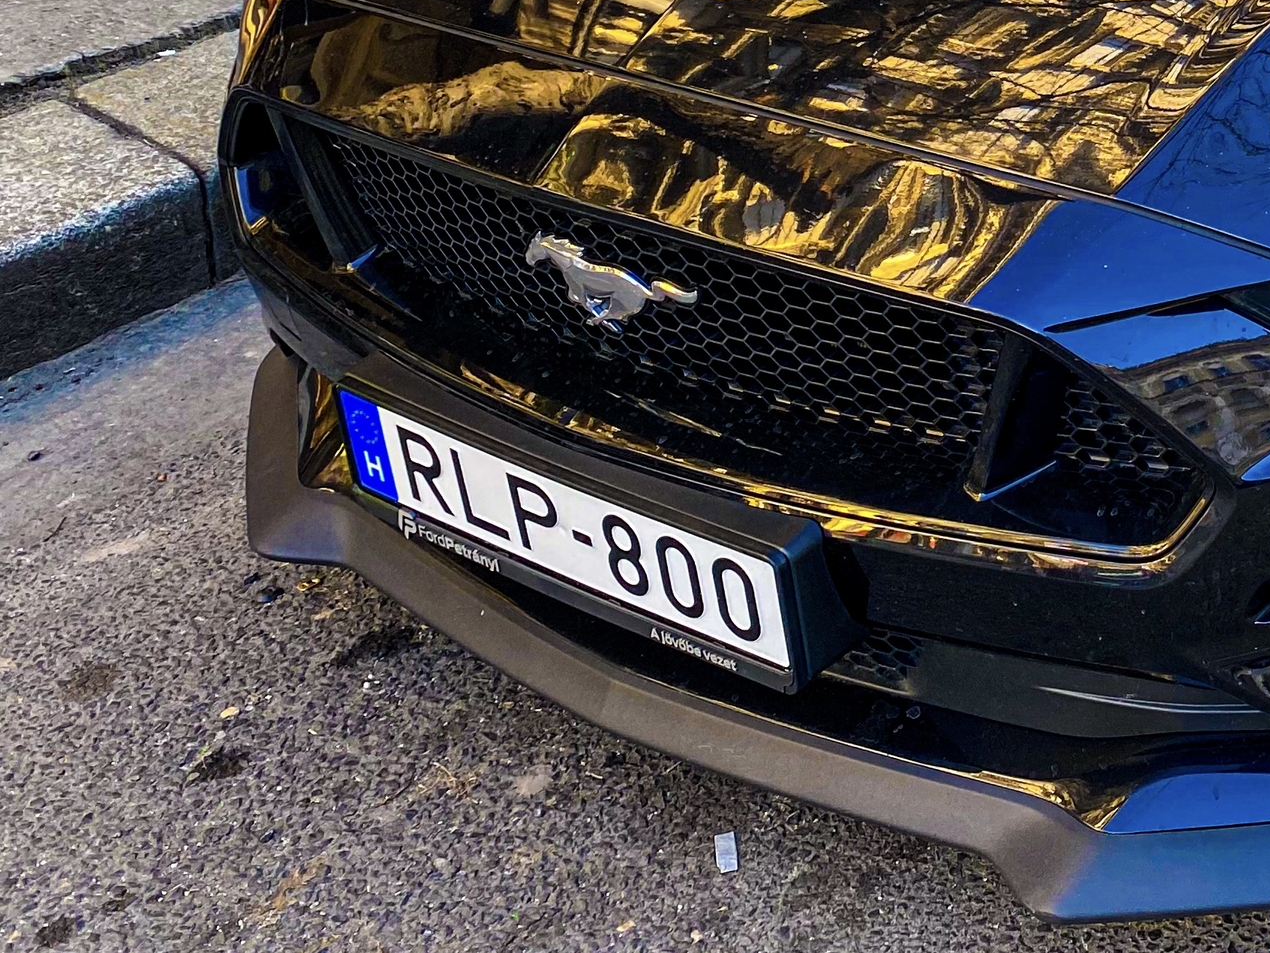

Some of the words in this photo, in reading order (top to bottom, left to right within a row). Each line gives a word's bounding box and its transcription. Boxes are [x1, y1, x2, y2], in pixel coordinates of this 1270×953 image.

[365, 452, 385, 483] H
[396, 425, 761, 643] RLP-800
[651, 628, 660, 641] A
[702, 649, 737, 671] vezet
